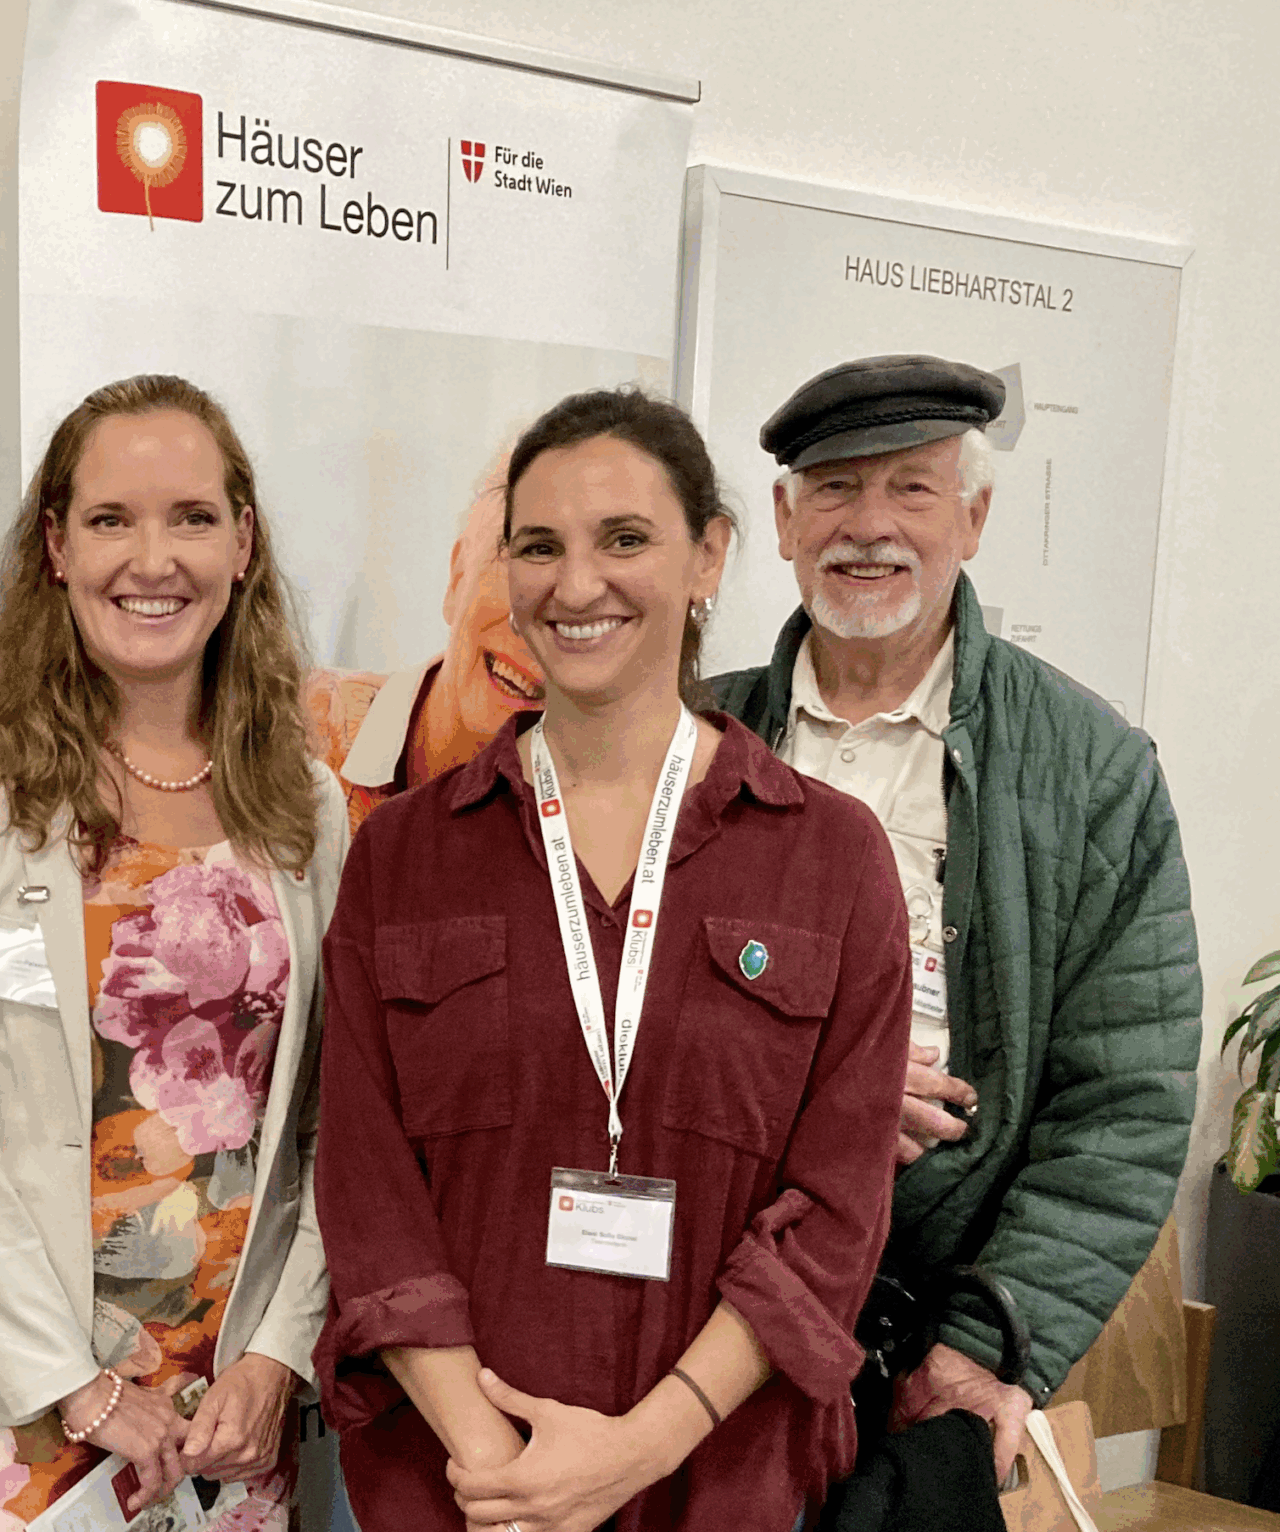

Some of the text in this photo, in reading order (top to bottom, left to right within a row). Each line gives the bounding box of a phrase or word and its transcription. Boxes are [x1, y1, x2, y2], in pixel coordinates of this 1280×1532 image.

[217, 111, 363, 179] Häuser
[495, 145, 544, 170] Für die
[216, 180, 438, 245] zum Leben
[494, 170, 572, 198] Stadt Wien
[845, 255, 1074, 312] HAUS LIEBHARTSTAL 2
[542, 768, 555, 799] Klubs
[641, 754, 685, 884] häuserzumleben.at
[551, 836, 591, 981] häuserzumleben.at
[626, 930, 642, 966] Klubs
